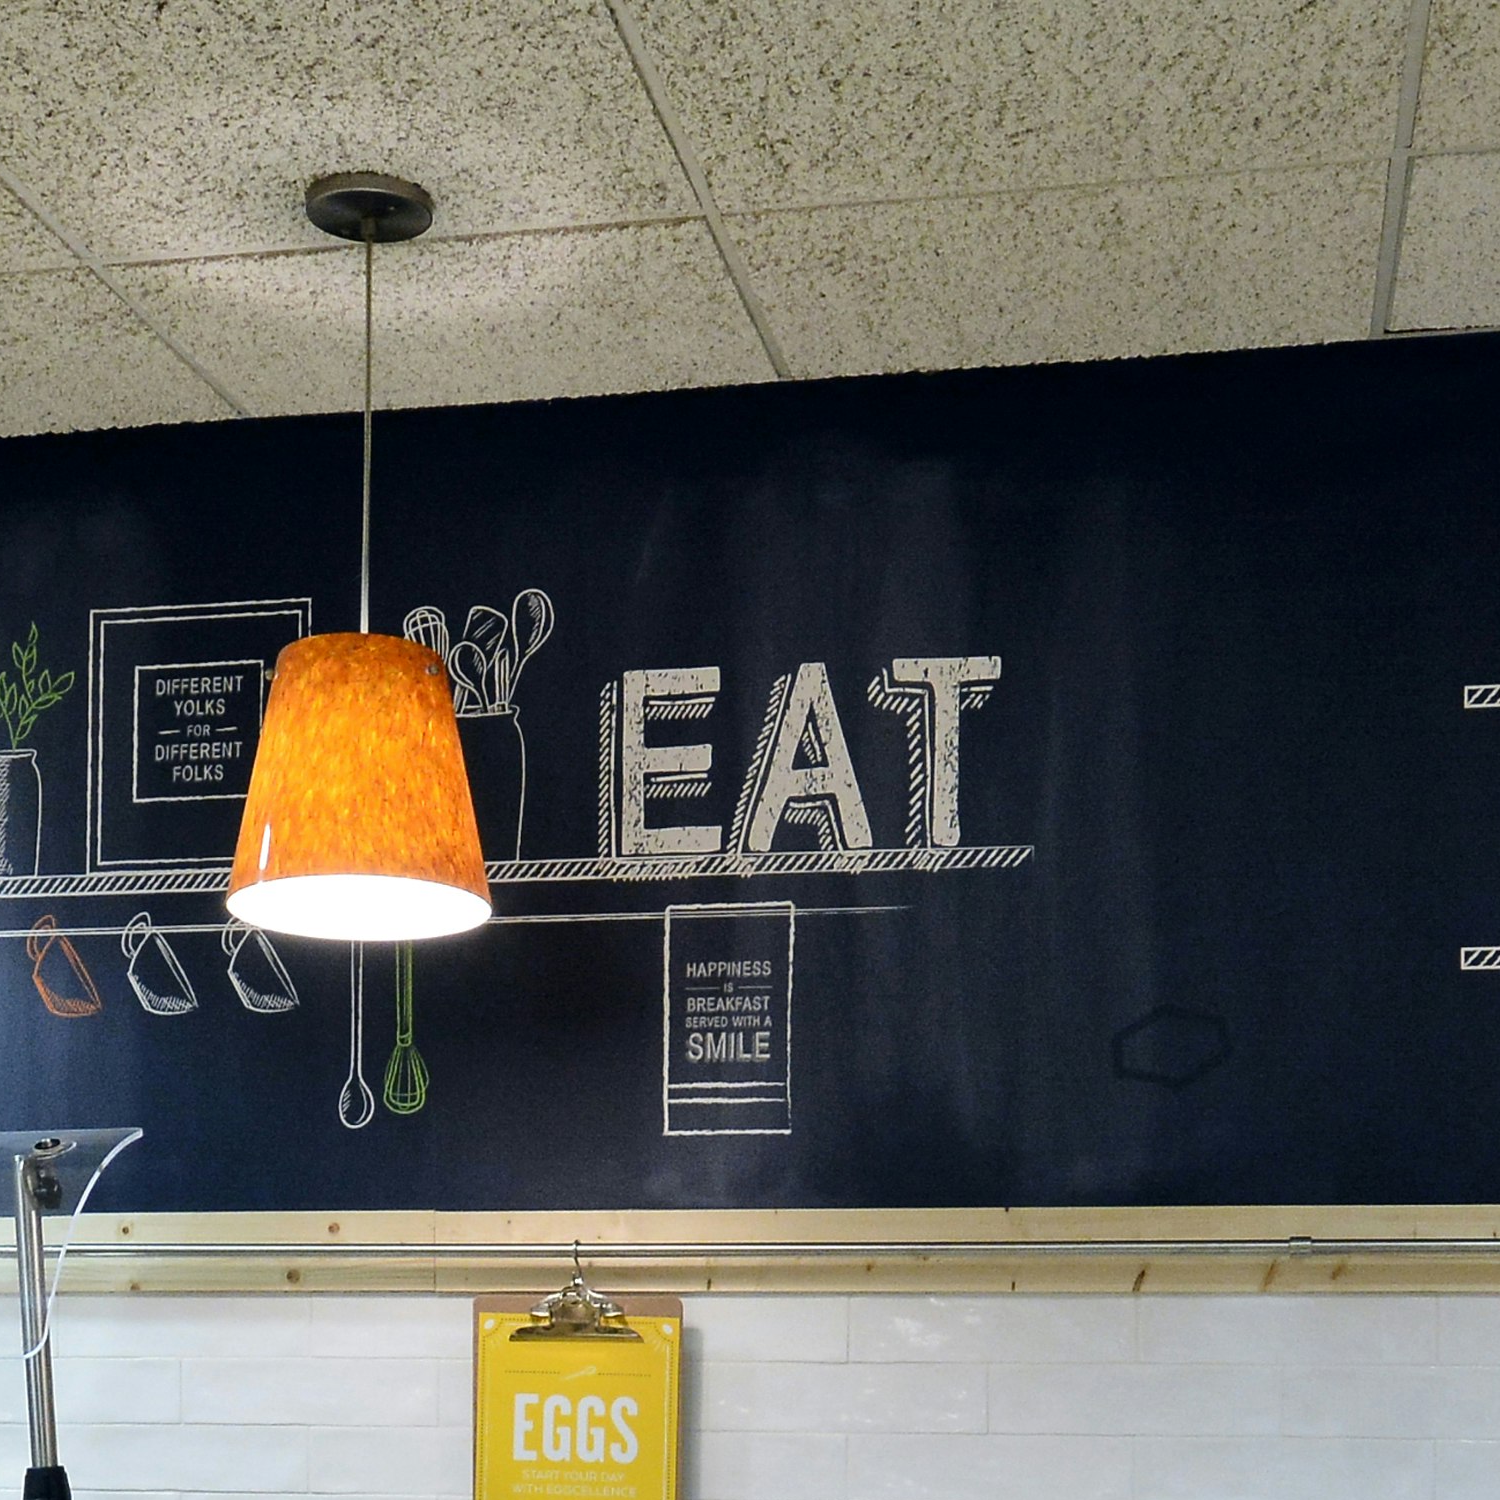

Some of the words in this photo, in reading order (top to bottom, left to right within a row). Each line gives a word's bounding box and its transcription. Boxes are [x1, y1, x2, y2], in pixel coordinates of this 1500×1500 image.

[155, 675, 244, 697] DIFFERENT
[173, 698, 226, 716] YOLKS
[186, 723, 211, 737] FOR
[154, 741, 243, 761] DIFFERENT
[599, 656, 1001, 857] EAT
[172, 765, 224, 783] FOLKS
[686, 961, 772, 978] HAPPINESS
[723, 982, 734, 993] IS
[687, 996, 771, 1013] BREAKFAST
[685, 1016, 729, 1028] SERVED
[732, 1016, 761, 1027] WITH
[764, 1015, 772, 1027] A
[686, 1031, 771, 1063] SMILE
[513, 1393, 639, 1464] EGGS
[522, 1470, 560, 1480] START
